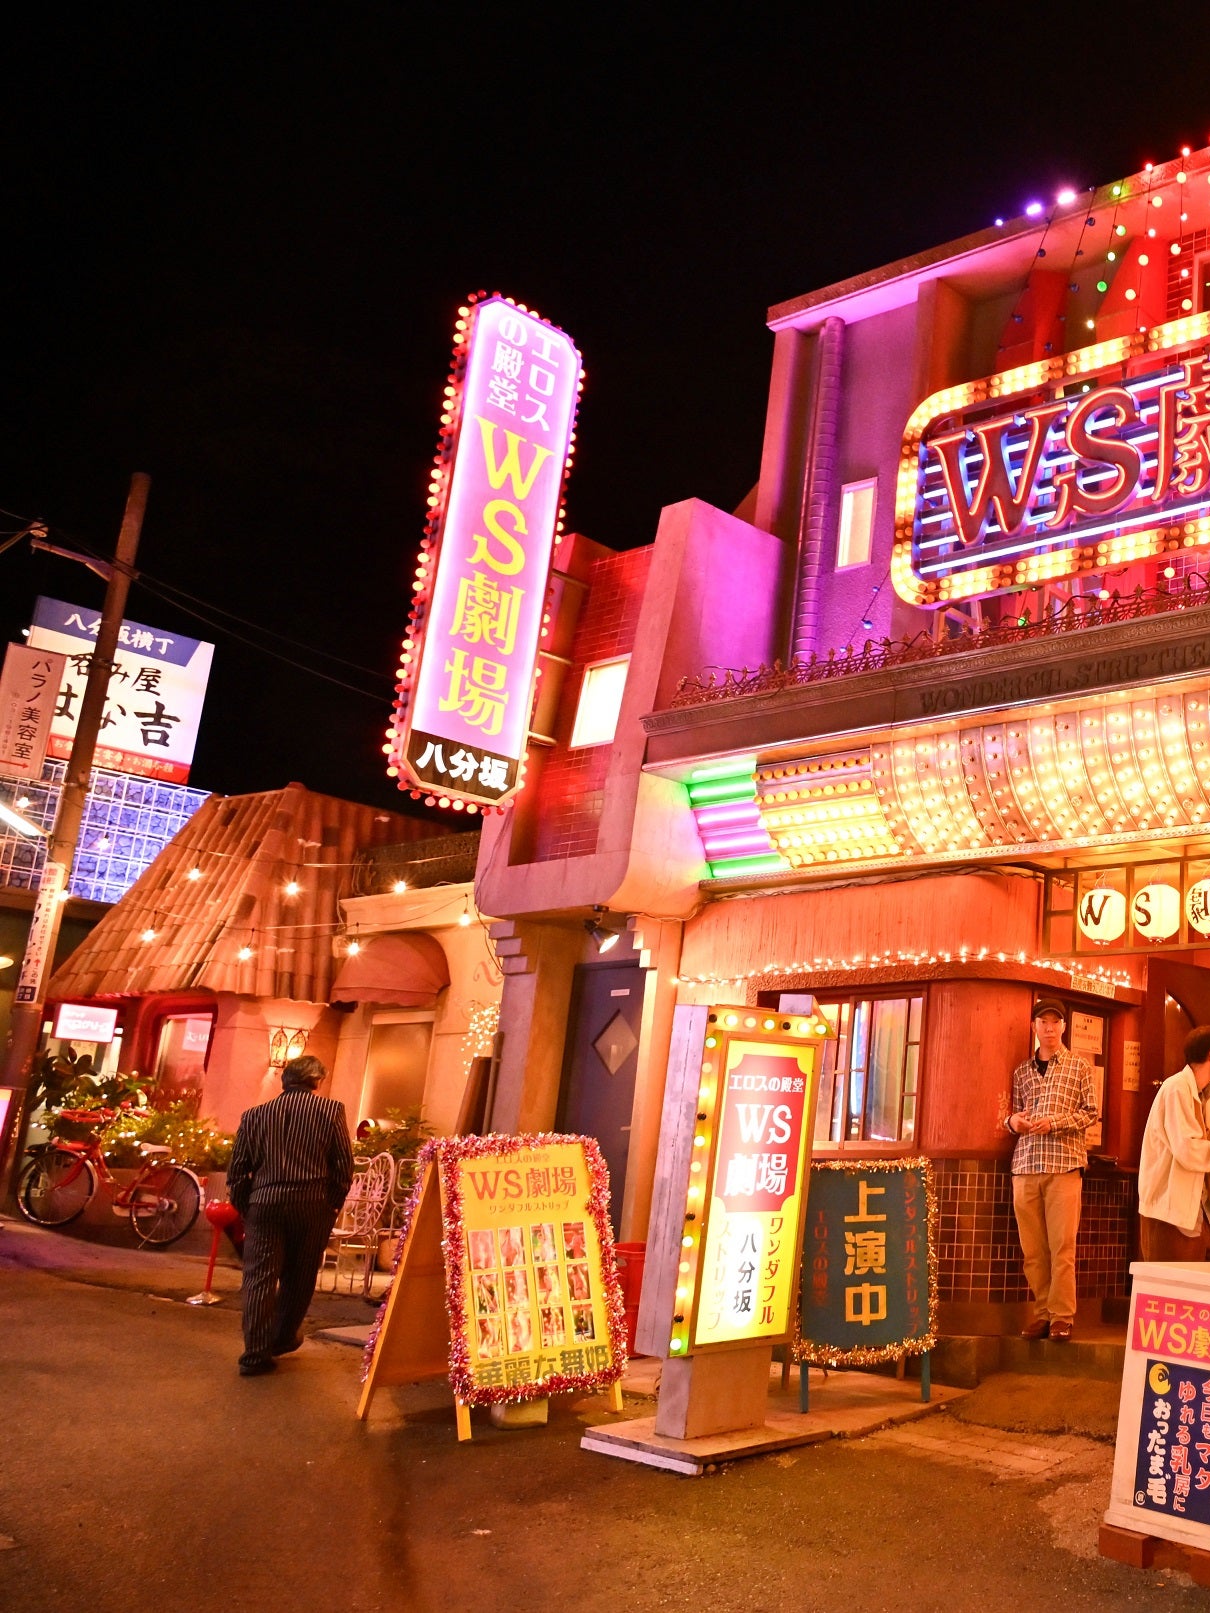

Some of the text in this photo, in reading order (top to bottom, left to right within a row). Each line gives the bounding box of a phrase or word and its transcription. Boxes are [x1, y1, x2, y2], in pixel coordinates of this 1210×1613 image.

[486, 315, 528, 417] の殿堂
[520, 334, 562, 432] エロス
[438, 415, 555, 736] WS劇場
[920, 670, 1068, 713] WONDERFUL
[1073, 654, 1149, 687] STRIP
[416, 741, 510, 791] 八分坂
[729, 1074, 804, 1093] エロスの殿堂
[735, 1103, 792, 1145] WS
[467, 1166, 577, 1200] WS劇場
[489, 1200, 570, 1215] ワンダフルストリップ
[724, 1153, 788, 1197] 劇場
[707, 1221, 731, 1330] ストリップ
[733, 1233, 757, 1313] 八分坂
[759, 1216, 784, 1325] ワンダフル
[844, 1180, 888, 1327] 上演中
[1170, 1380, 1197, 1513] ゆれる乳房に
